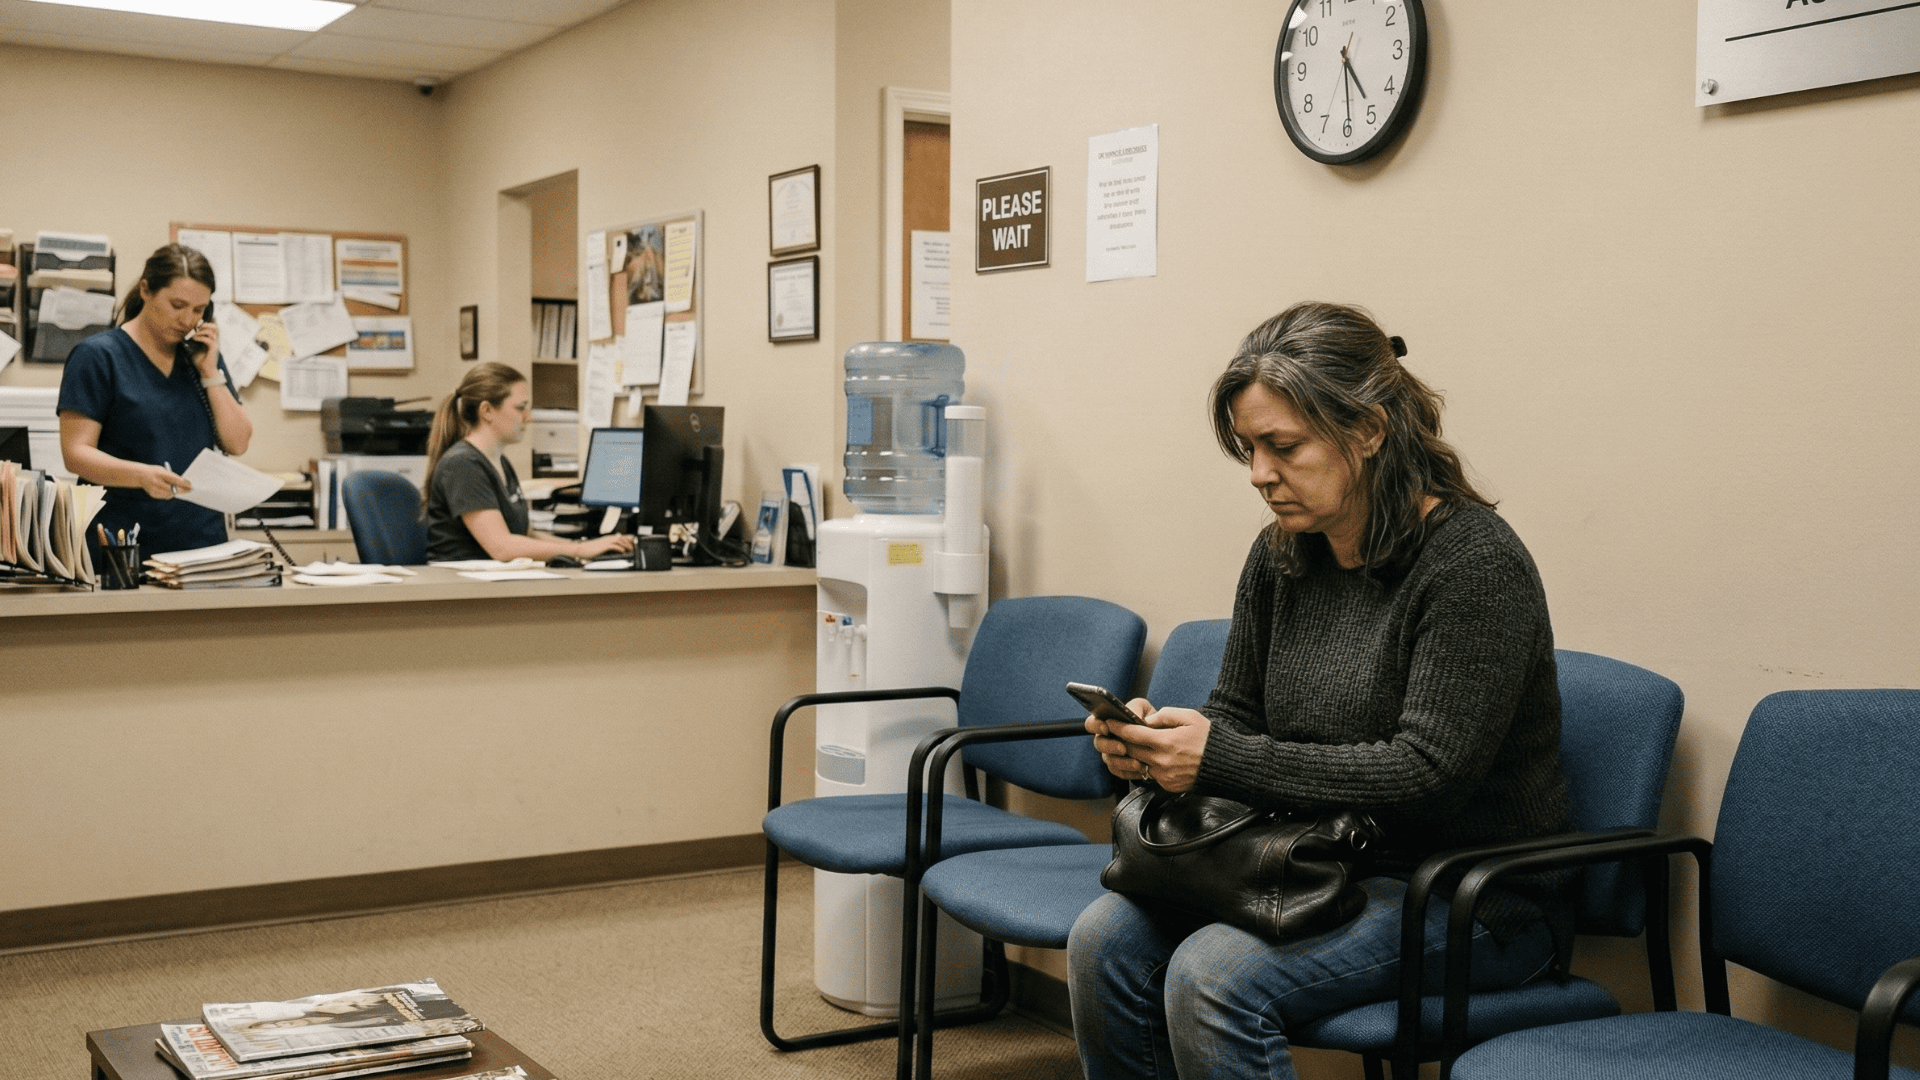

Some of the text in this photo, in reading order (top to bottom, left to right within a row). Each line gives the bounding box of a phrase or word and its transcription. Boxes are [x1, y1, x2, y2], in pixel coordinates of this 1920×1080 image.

[1319, 0, 1332, 18] 11
[1385, 5, 1396, 27] 2
[1302, 25, 1318, 47] 10
[1392, 39, 1403, 60] 3
[1297, 62, 1307, 81] 9
[1383, 75, 1395, 95] 4
[1303, 93, 1313, 113] 8
[1320, 114, 1330, 133] 7
[1366, 104, 1376, 124] 5
[1342, 118, 1352, 138] 6
[982, 190, 1042, 222] PLEASE
[992, 223, 1031, 251] WAIT
